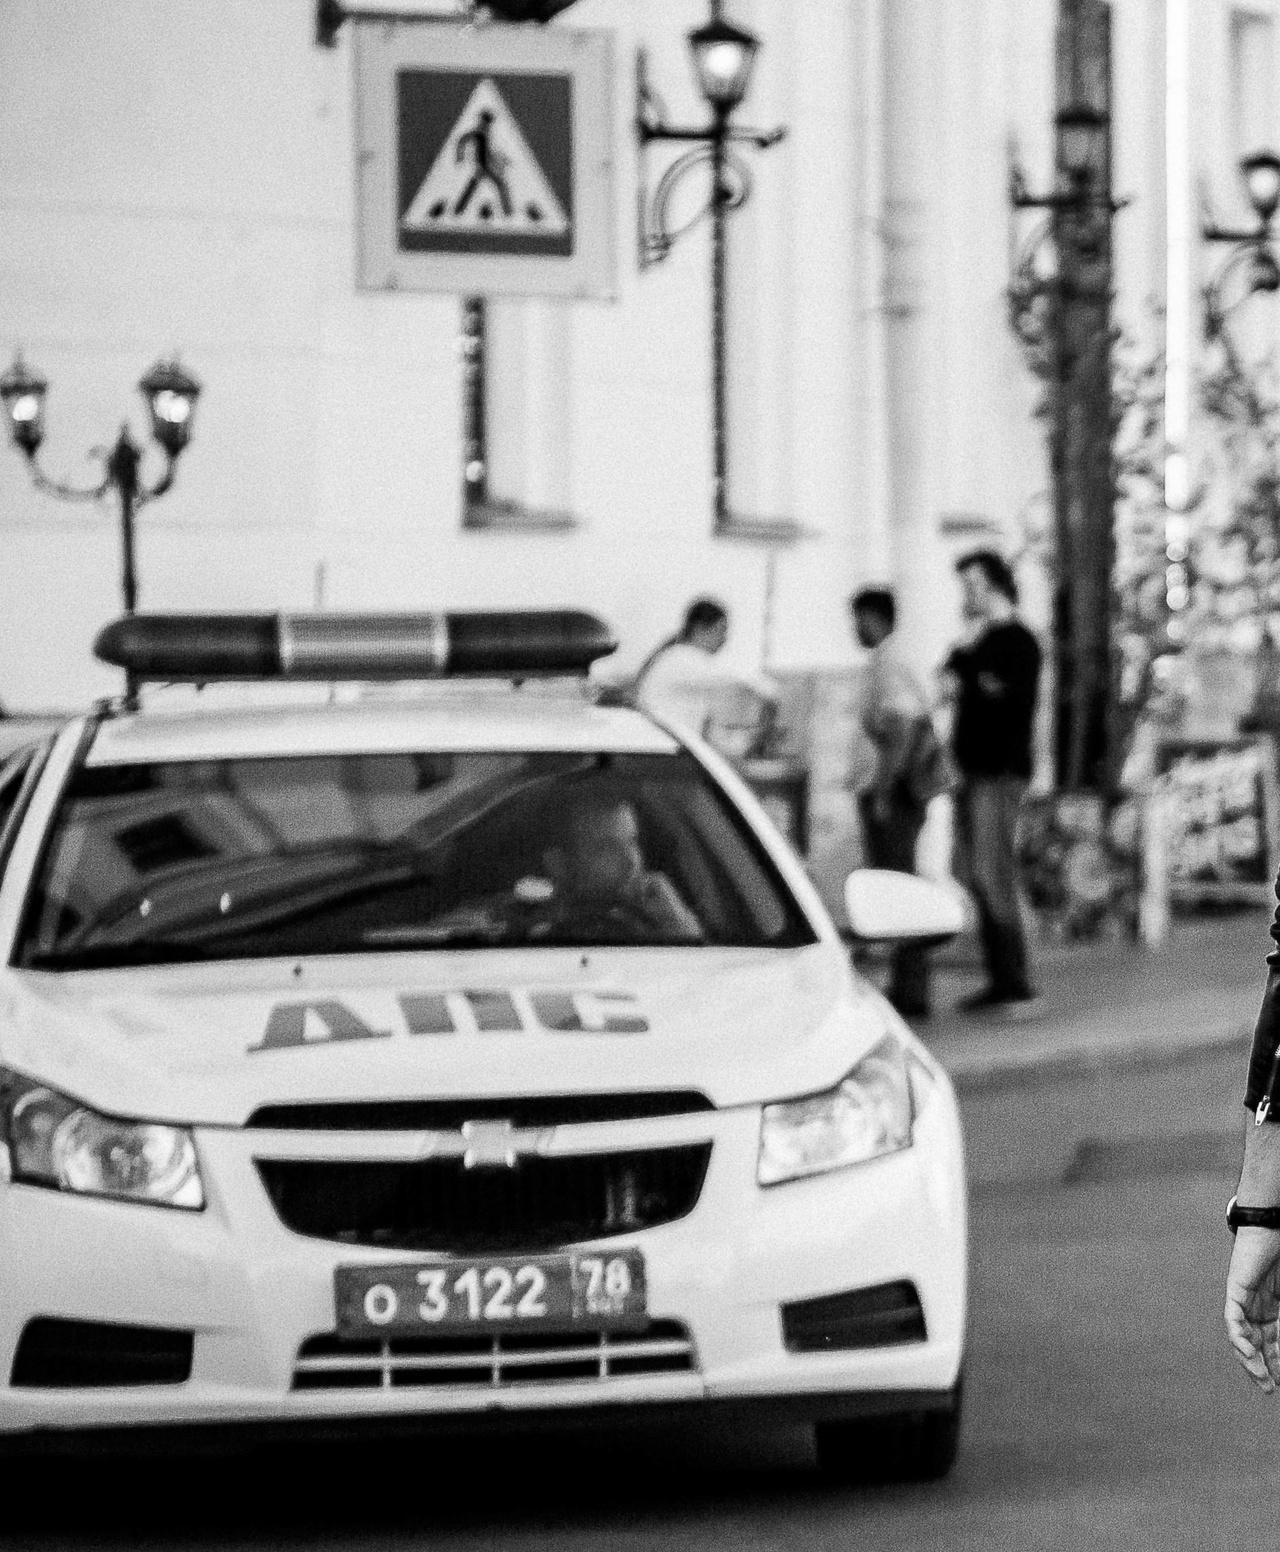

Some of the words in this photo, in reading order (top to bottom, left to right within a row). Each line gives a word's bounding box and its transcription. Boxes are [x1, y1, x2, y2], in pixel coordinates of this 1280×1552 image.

[246, 989, 650, 1053] ДПС
[416, 1265, 547, 1322] 3122
[579, 1258, 631, 1301] 78
